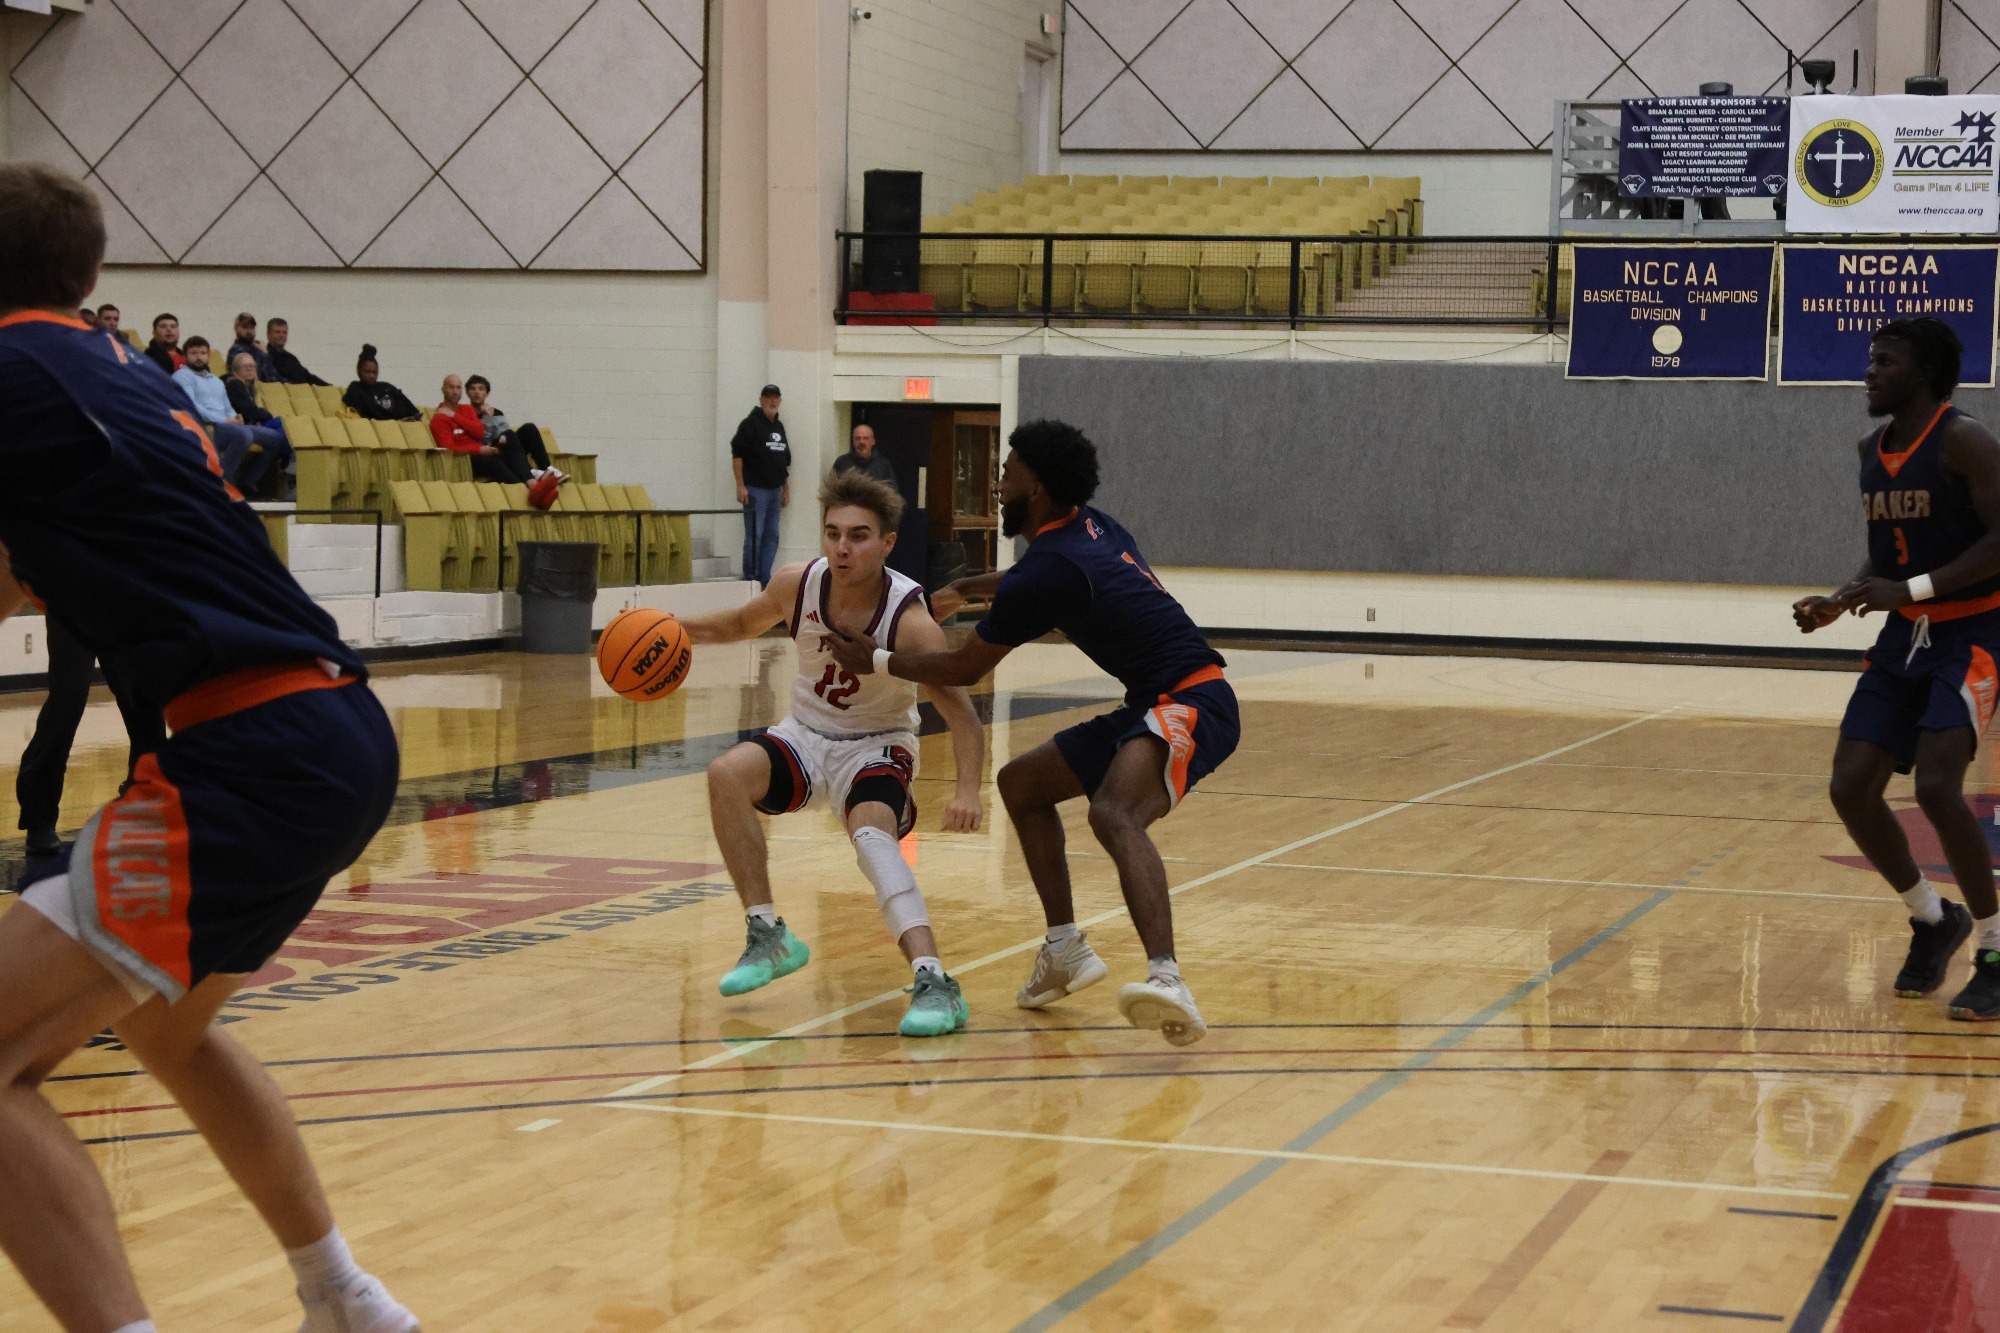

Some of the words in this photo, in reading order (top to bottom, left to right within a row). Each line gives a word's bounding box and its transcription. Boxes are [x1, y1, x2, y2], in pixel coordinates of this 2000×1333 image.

[1658, 98, 1677, 106] OUR
[1679, 98, 1708, 106] SILVER
[1710, 98, 1757, 106] SPONSORS
[1895, 127, 1944, 137] Member
[1894, 144, 1993, 168] NCCAA
[1872, 147, 1882, 185] INTEGRITY
[1651, 184, 1675, 193] Thank
[1676, 185, 1691, 193] You
[1690, 185, 1704, 196] for
[1704, 185, 1724, 193] Your
[1724, 185, 1757, 196] Support!
[1893, 182, 1925, 192] Game
[1927, 182, 1952, 192] Plan
[1954, 182, 1962, 192] 4
[1964, 182, 1990, 192] LIFE
[1898, 206, 1984, 216] www.thenccaa.org
[1839, 254, 1938, 275] NCCAA
[1624, 260, 1718, 286] NCCAA
[1846, 280, 1929, 294] NATIONAL
[1583, 289, 1664, 304] BASKETBALL
[1687, 290, 1758, 304] CHAMPIONS
[1802, 298, 1886, 313] BASKETBALL
[1896, 298, 1974, 313] CHAMPIONS
[1631, 307, 1681, 321] DIVISION
[1651, 356, 1680, 368] 1978
[907, 379, 930, 397] EXIT
[631, 635, 669, 676] NCAA
[814, 662, 861, 711] 12
[537, 882, 737, 931] BAPTIST
[359, 930, 570, 972] BIBLE
